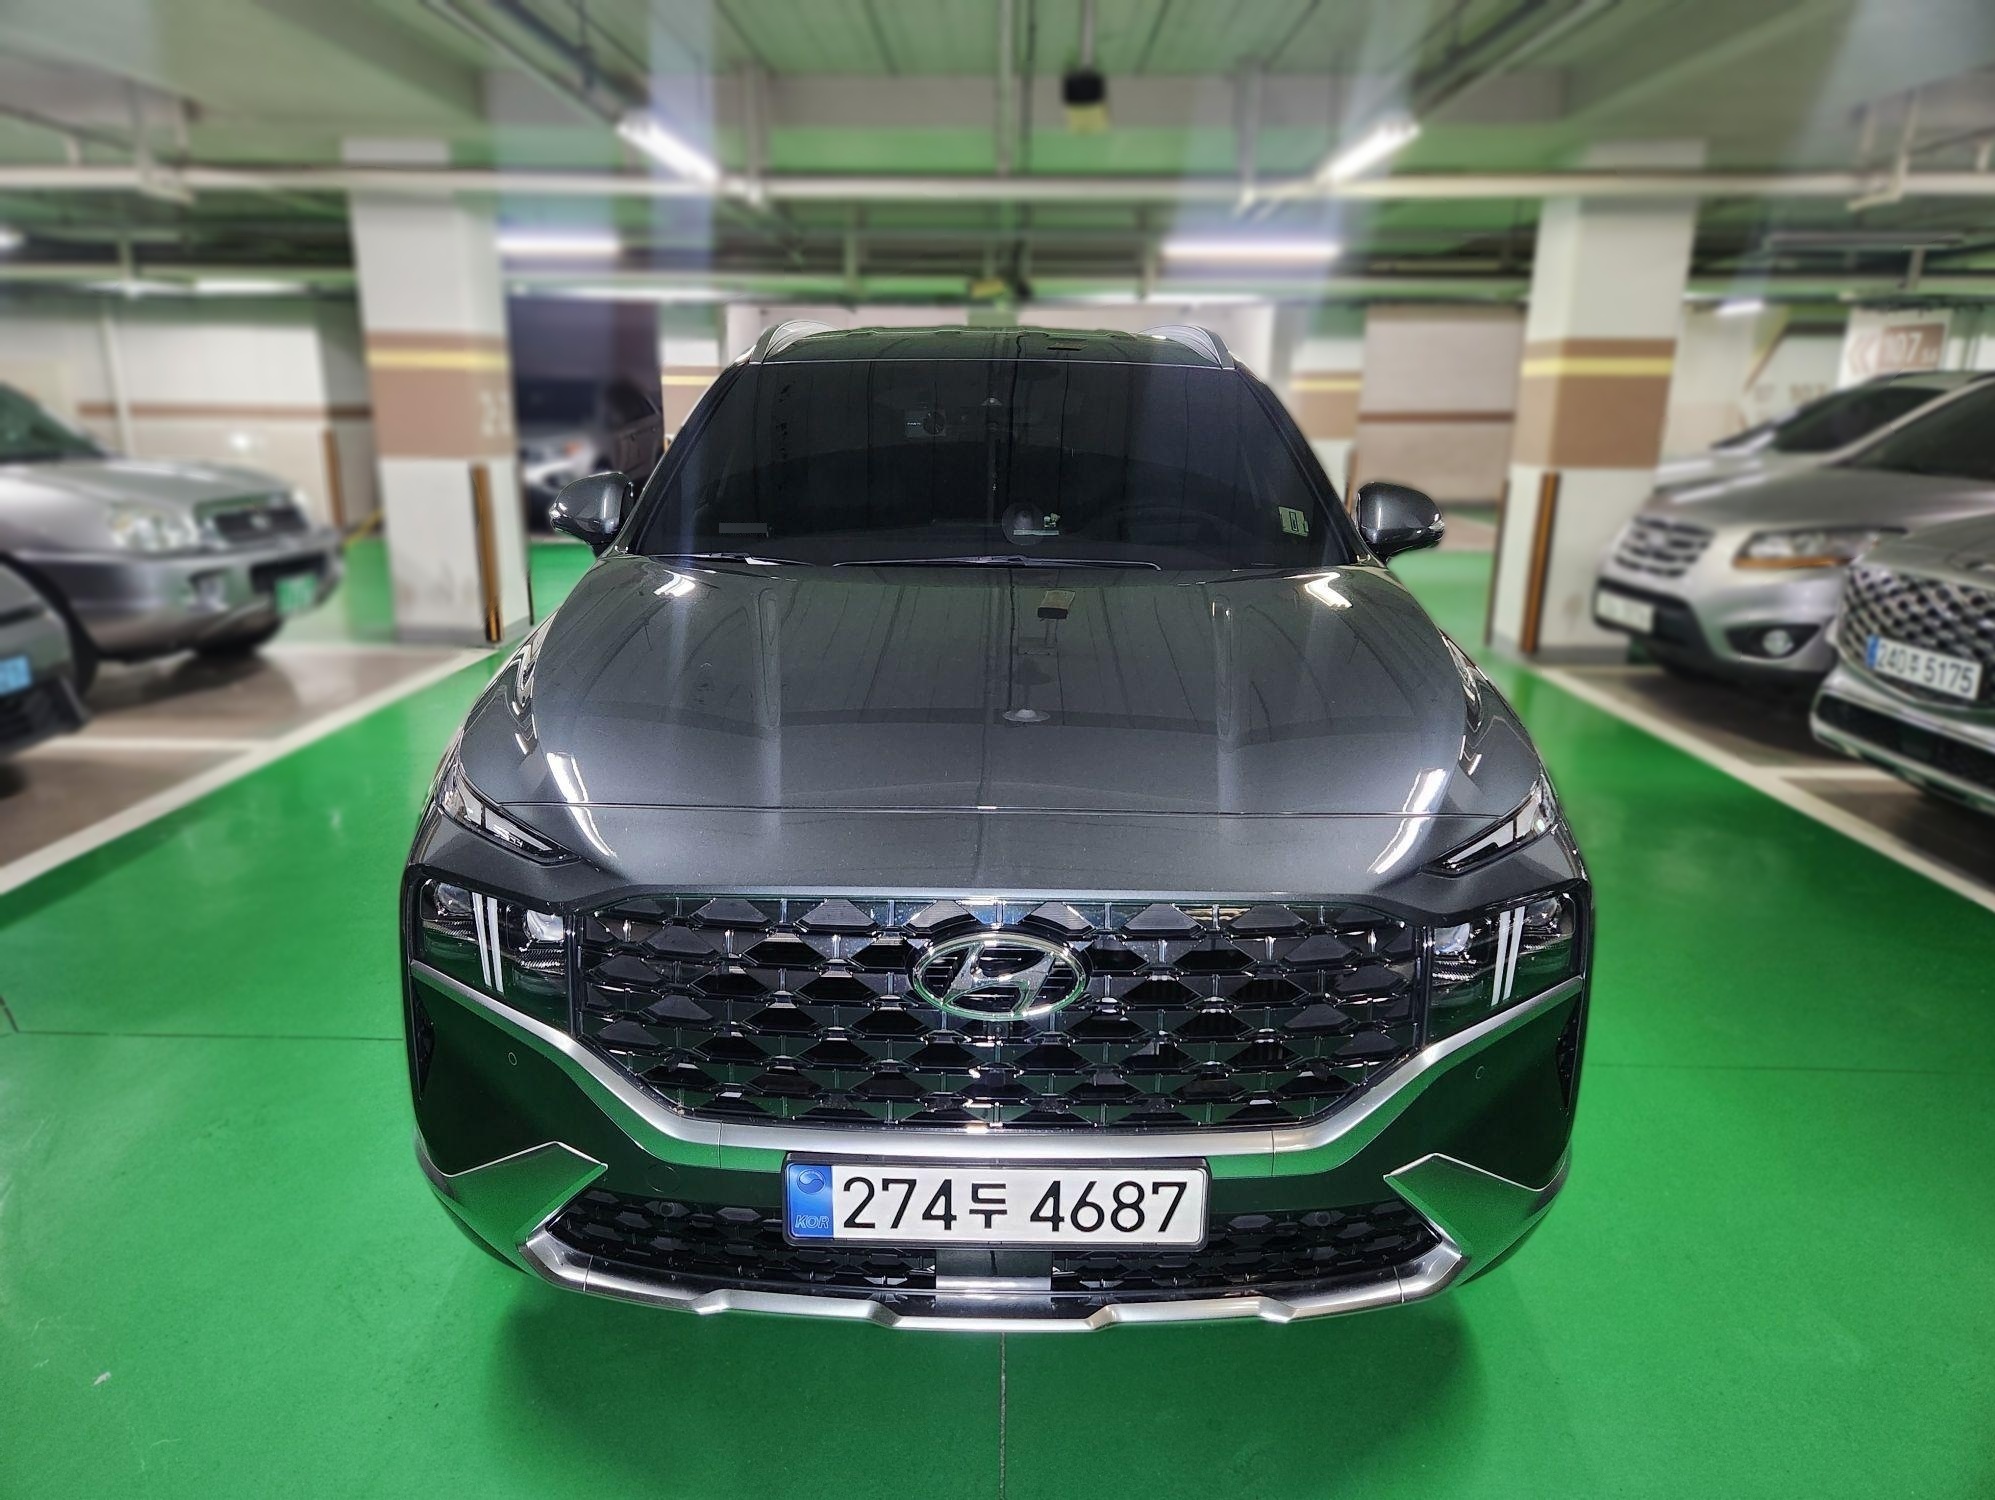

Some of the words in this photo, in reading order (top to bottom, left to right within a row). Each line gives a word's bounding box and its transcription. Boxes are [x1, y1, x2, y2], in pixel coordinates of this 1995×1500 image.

[1923, 655, 1975, 695] 5175
[795, 1214, 830, 1229] KOR
[842, 1176, 1008, 1231] 274두
[1029, 1180, 1188, 1233] 4687
